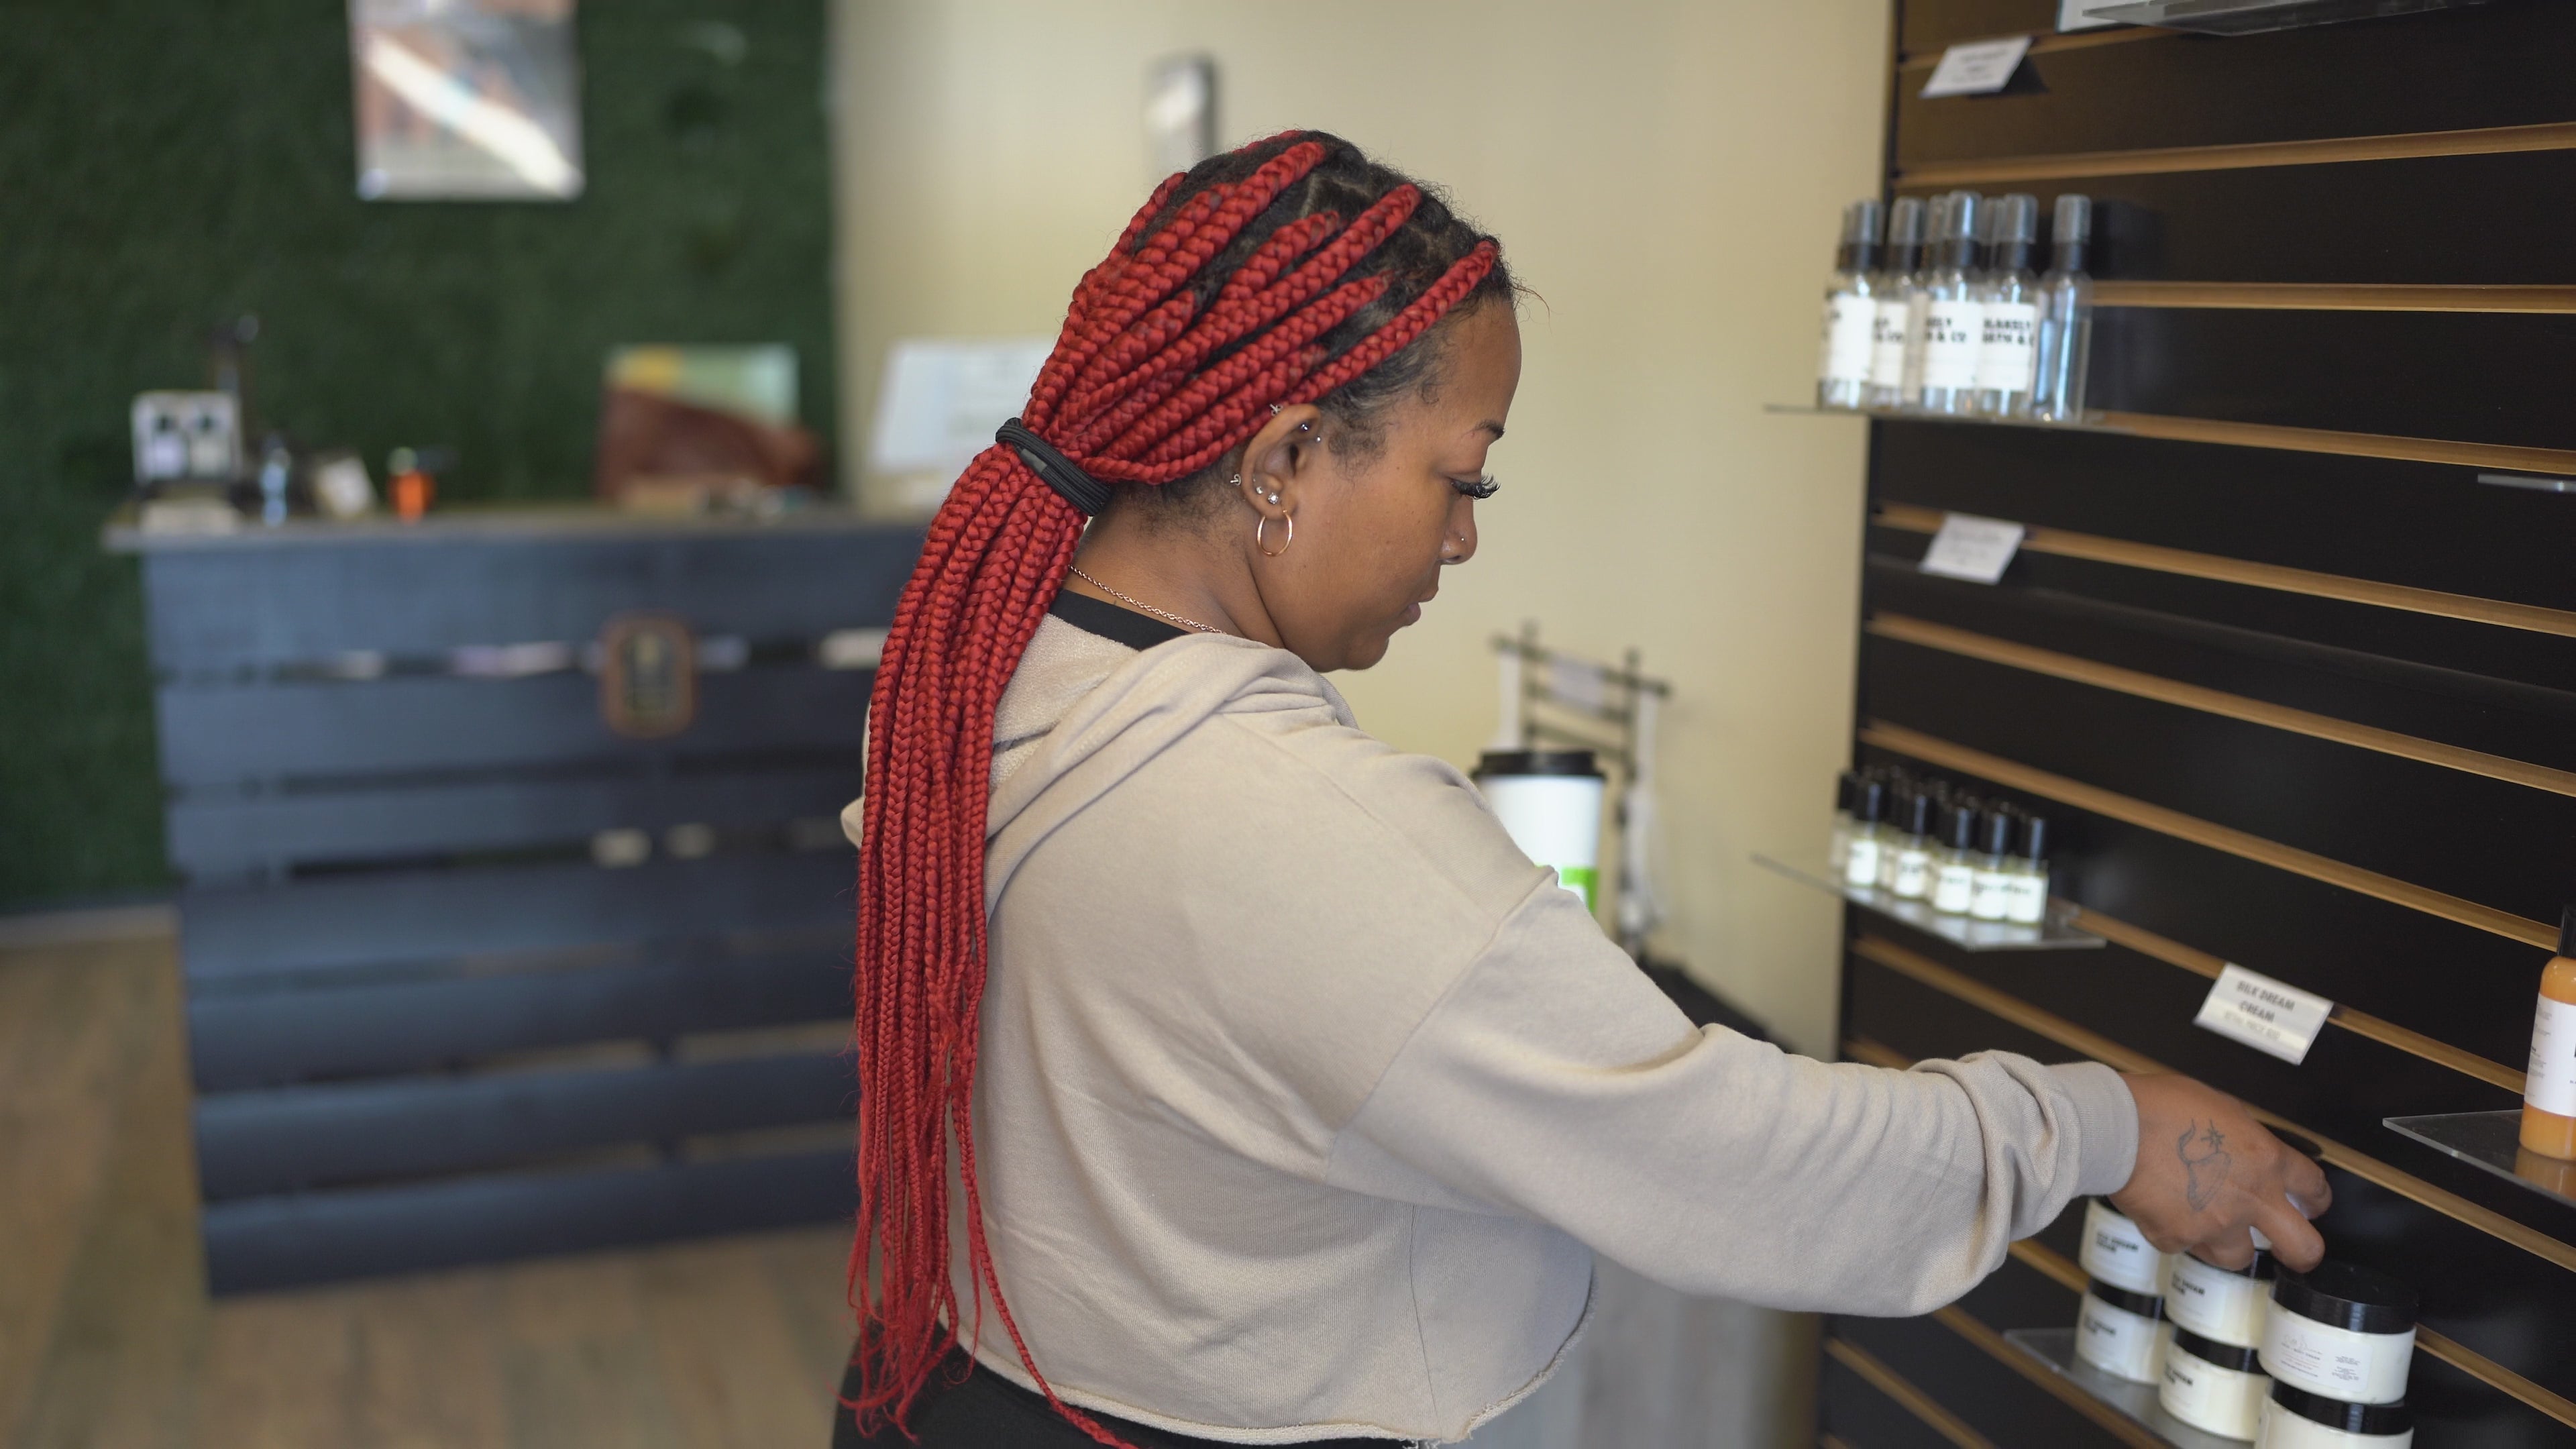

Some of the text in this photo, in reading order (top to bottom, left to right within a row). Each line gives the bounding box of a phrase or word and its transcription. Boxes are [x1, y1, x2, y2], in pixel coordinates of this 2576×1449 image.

[2237, 980, 2296, 1012] SILK DREAM
[2239, 1000, 2275, 1023] CREAM
